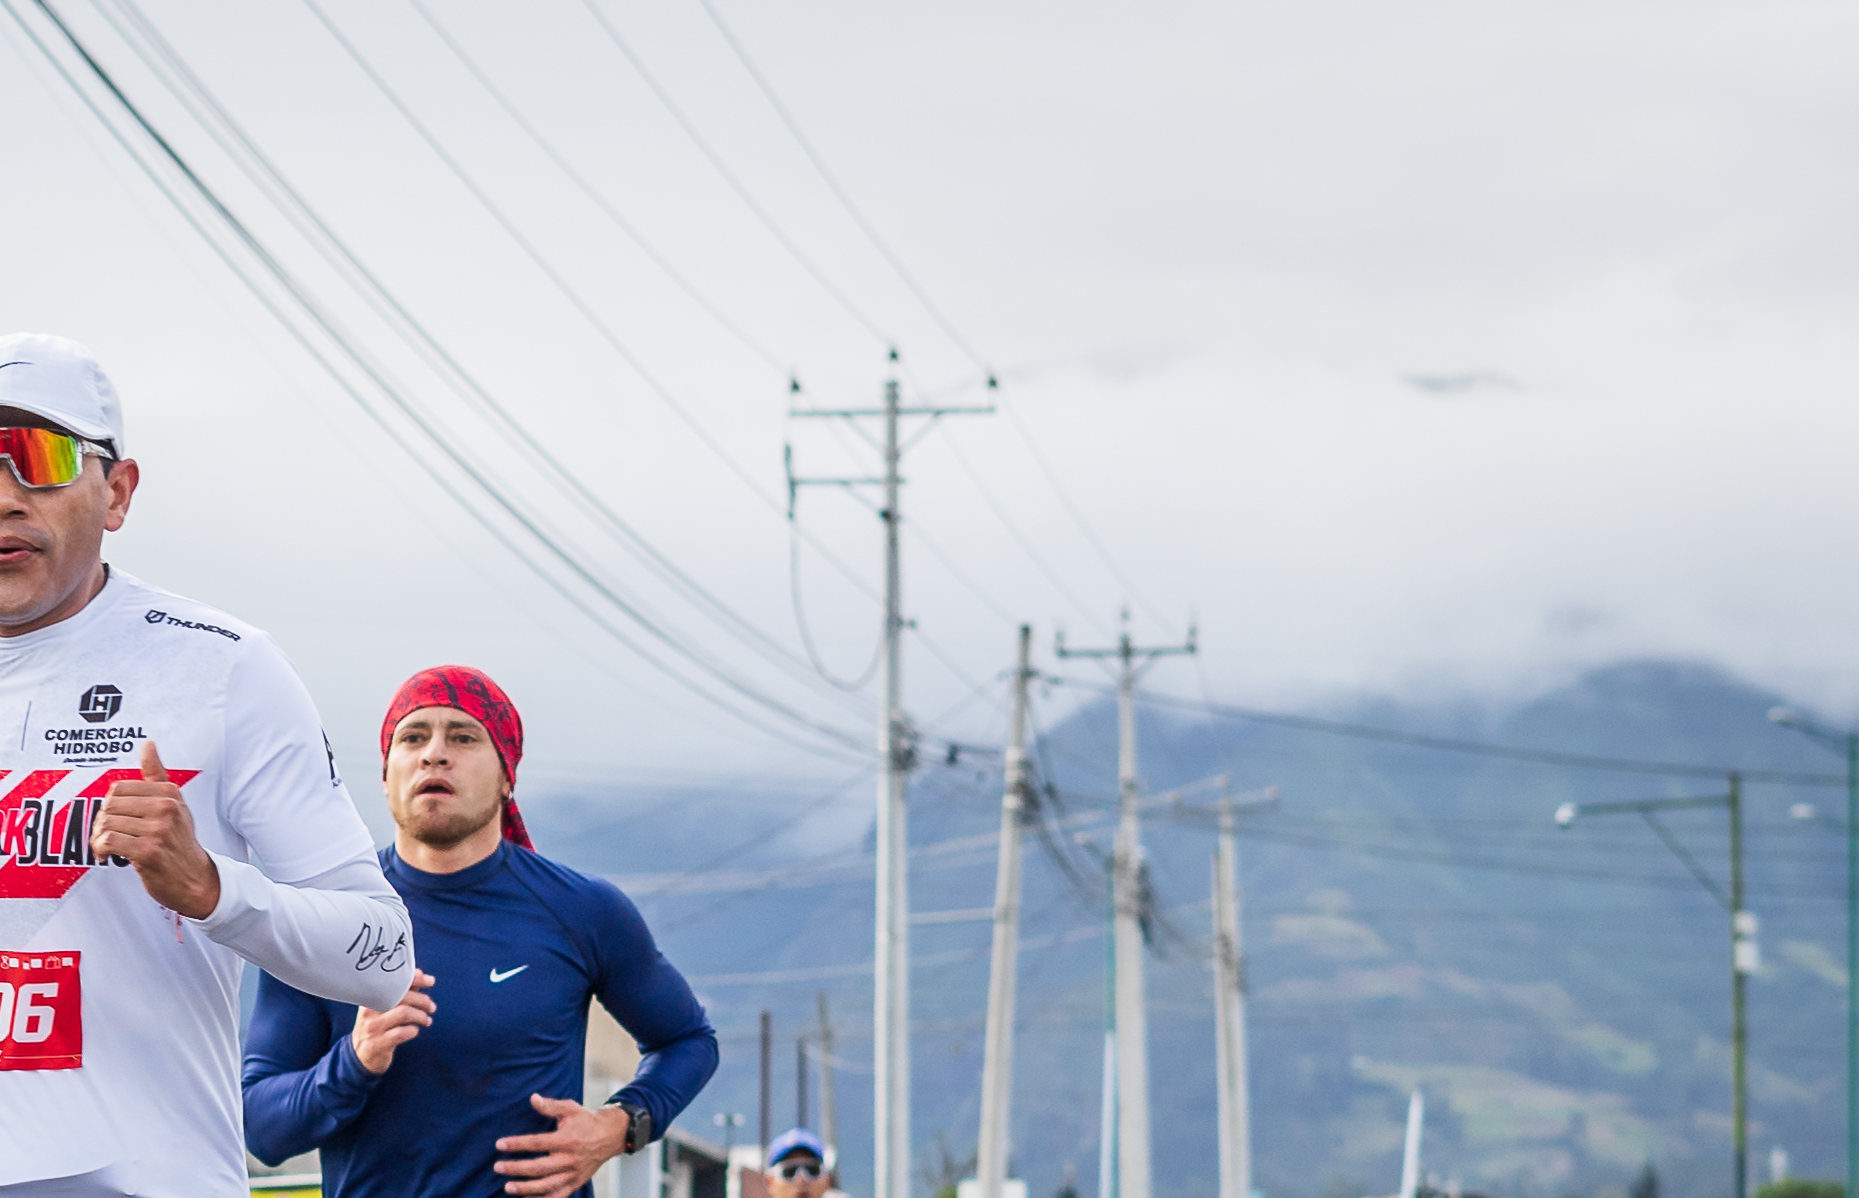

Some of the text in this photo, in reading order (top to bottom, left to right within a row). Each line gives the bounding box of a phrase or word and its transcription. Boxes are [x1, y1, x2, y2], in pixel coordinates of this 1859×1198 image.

[166, 616, 241, 642] THUNDER
[44, 726, 147, 741] COMERCIAL
[53, 741, 134, 755] HIDROBO
